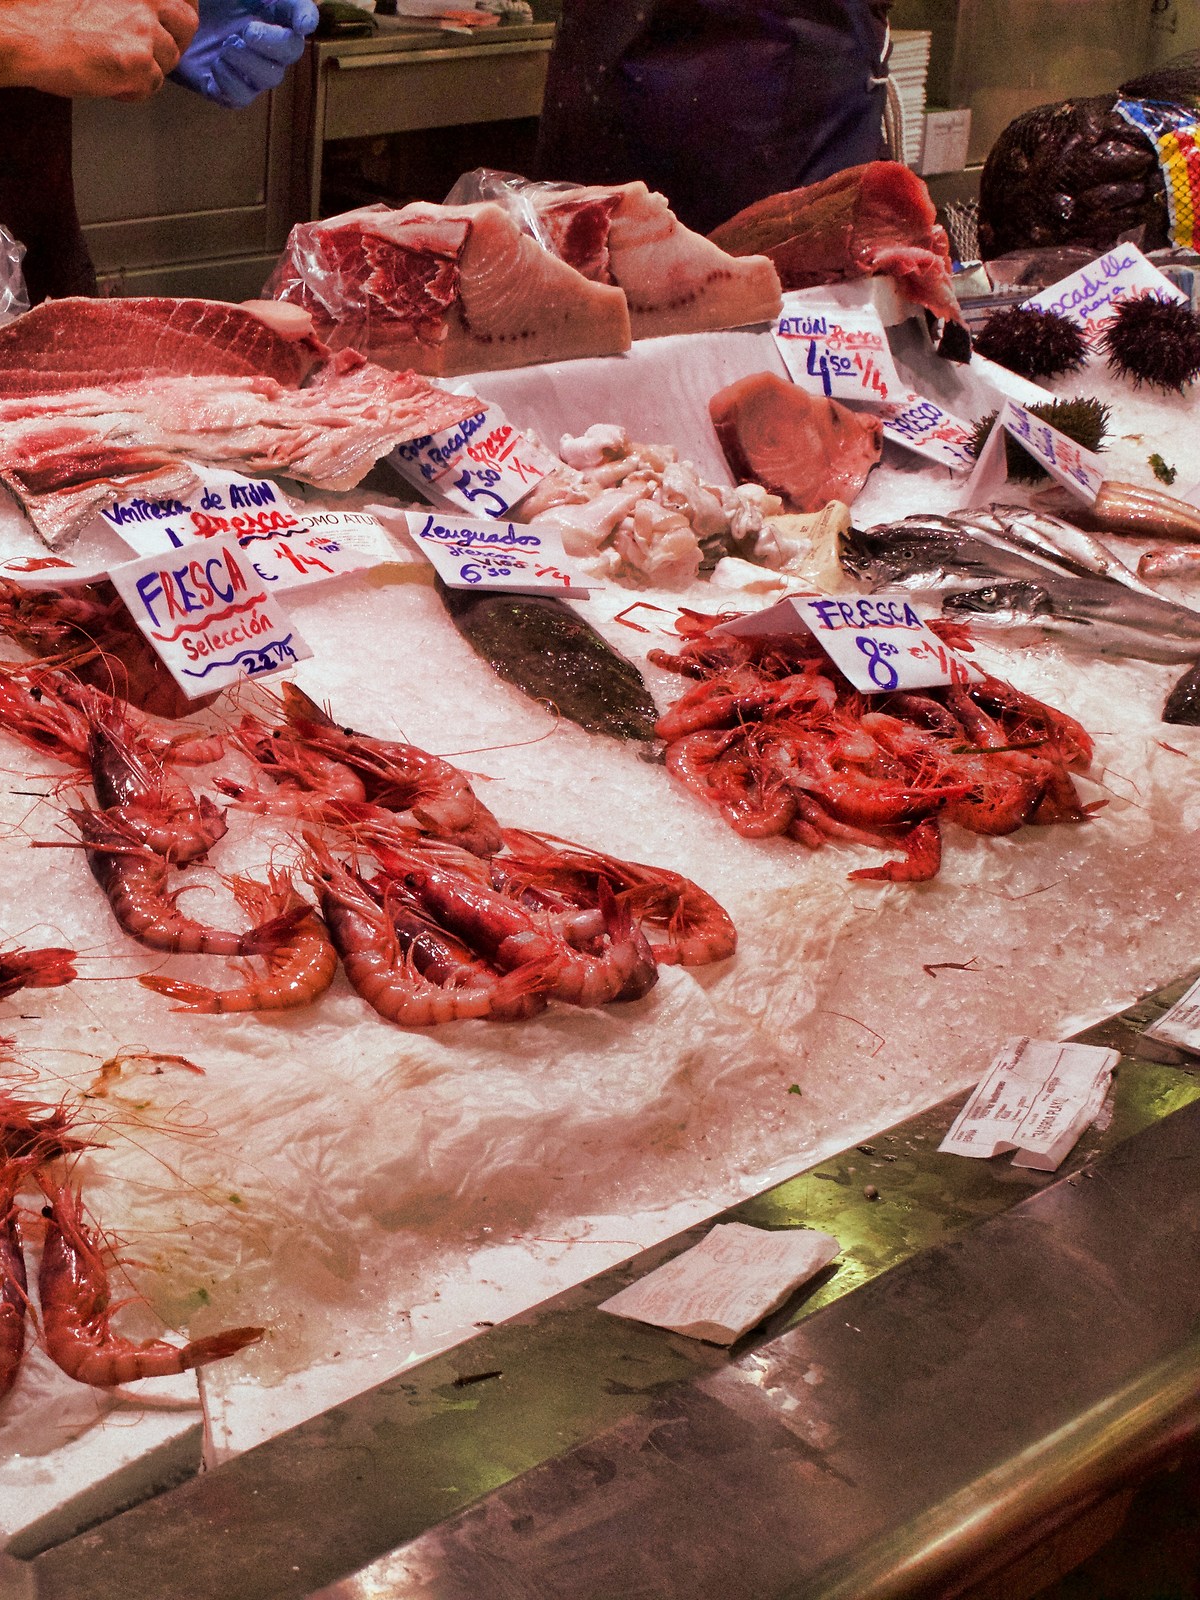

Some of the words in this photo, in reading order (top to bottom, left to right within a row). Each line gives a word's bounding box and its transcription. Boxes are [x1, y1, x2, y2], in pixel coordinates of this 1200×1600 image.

[201, 485, 226, 510] de
[136, 547, 248, 627] FRESCA
[808, 600, 924, 629] FRESCA
[181, 609, 274, 661] Selección
